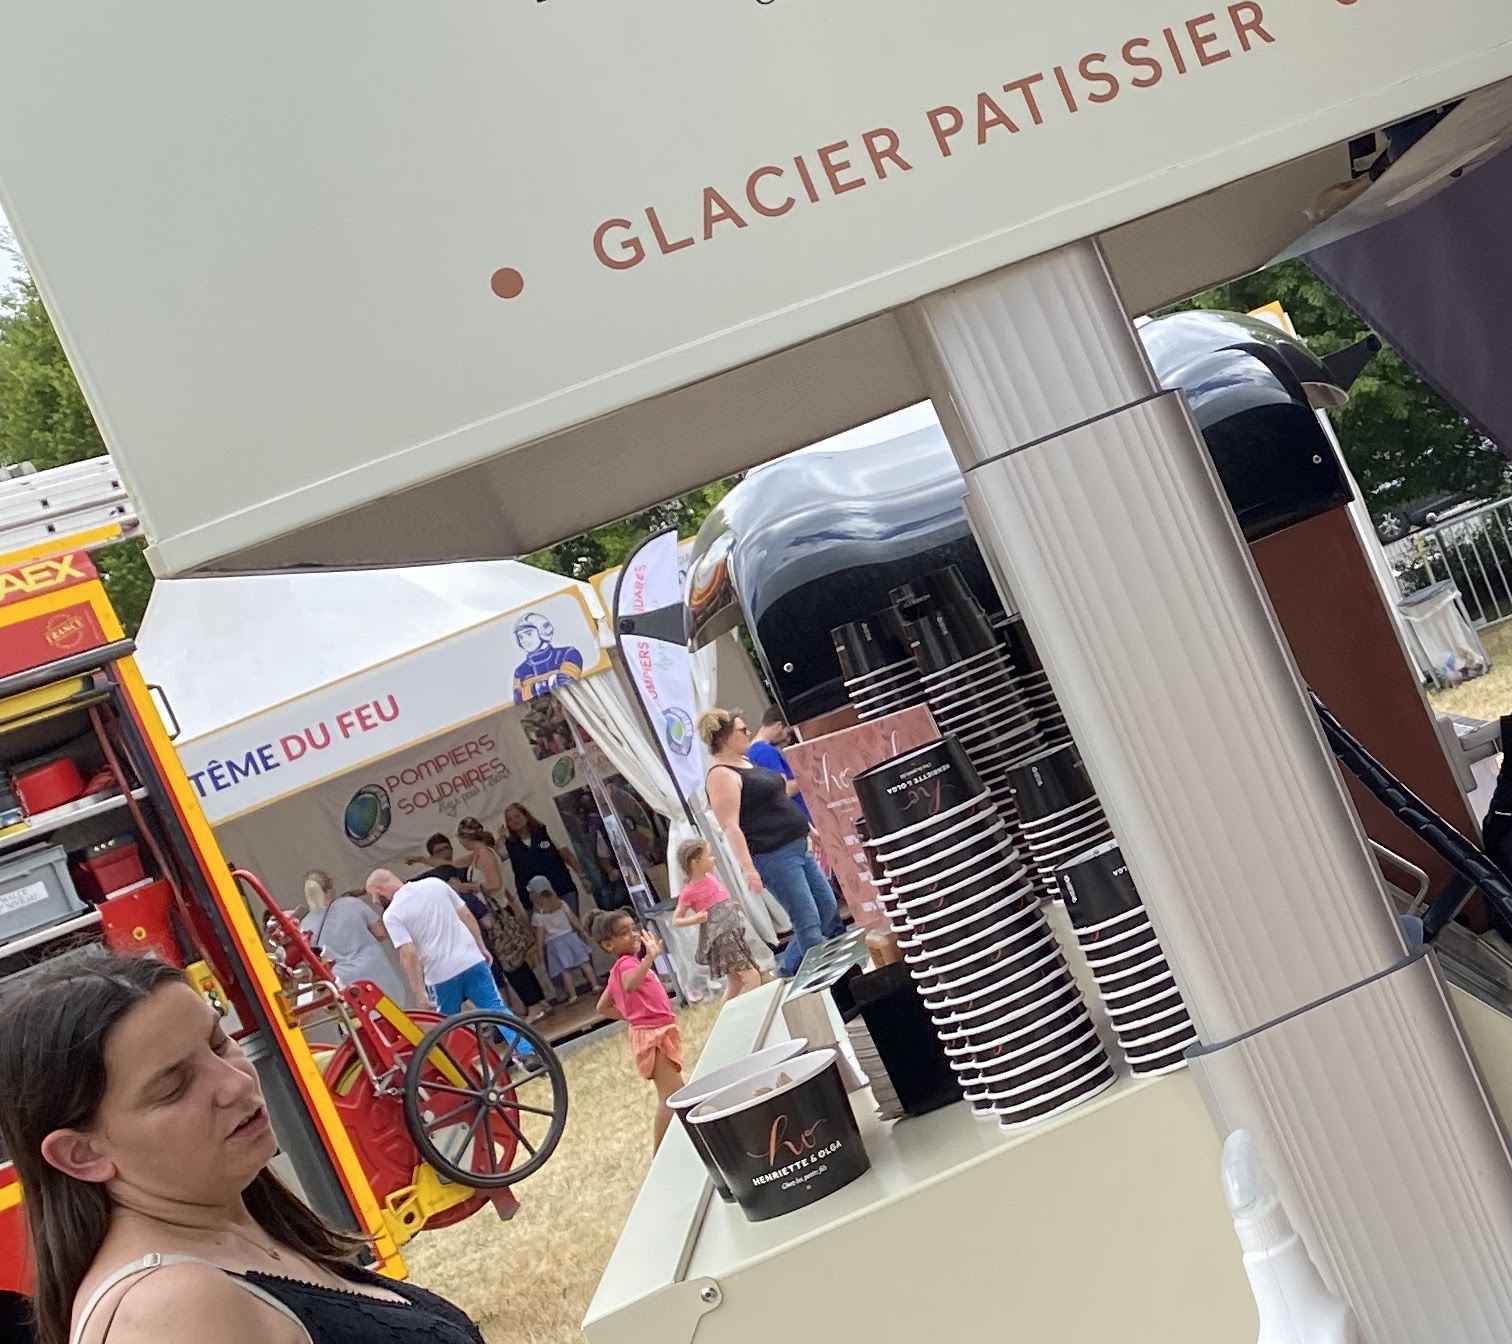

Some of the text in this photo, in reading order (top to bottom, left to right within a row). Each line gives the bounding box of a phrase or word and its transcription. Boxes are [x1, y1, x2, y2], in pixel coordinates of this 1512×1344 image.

[592, 0, 1276, 270] GLACIER PATISSIER
[279, 722, 332, 762] DU
[336, 694, 400, 739] FEU
[385, 734, 496, 793] POMPIERS
[397, 757, 506, 815] SOLIDAIRES
[752, 1158, 809, 1186] HENRIETTE
[818, 1140, 842, 1158] OLGA
